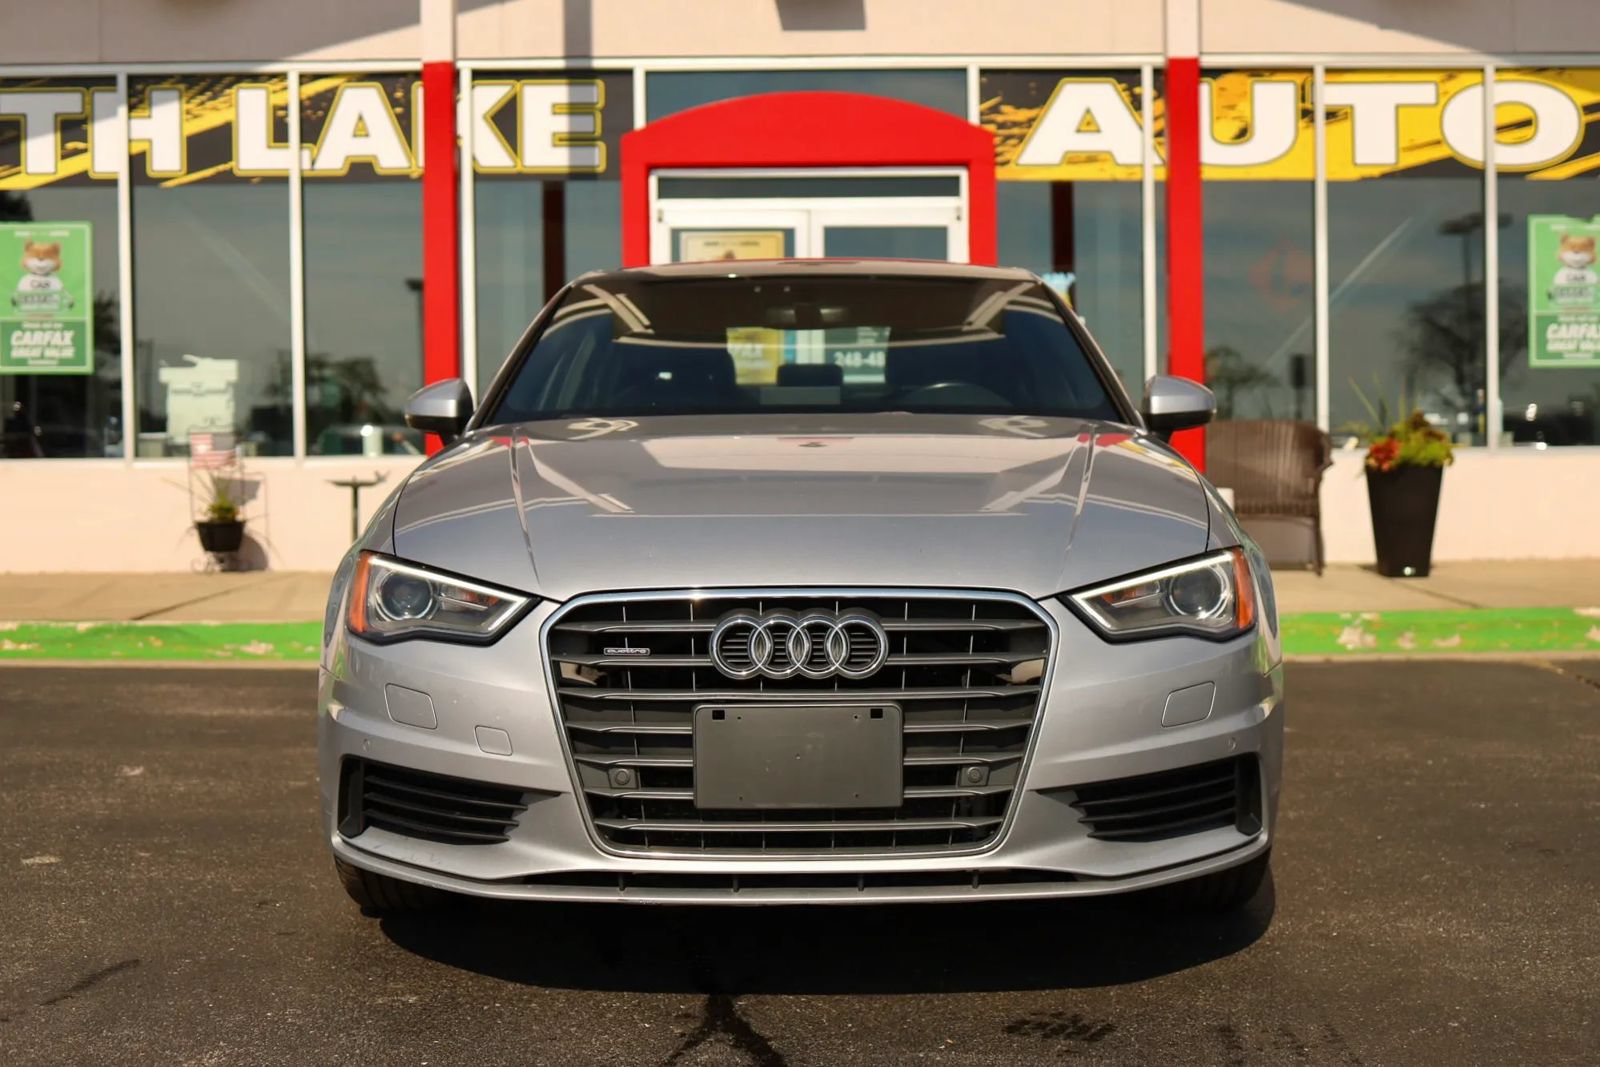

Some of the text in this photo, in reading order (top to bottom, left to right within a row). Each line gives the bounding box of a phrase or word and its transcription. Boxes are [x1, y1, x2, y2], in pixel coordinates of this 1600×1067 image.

[234, 80, 606, 175] LAKE
[1013, 78, 1584, 170] AUTO
[11, 330, 75, 346] CARFAX
[1546, 323, 1600, 339] CARFA
